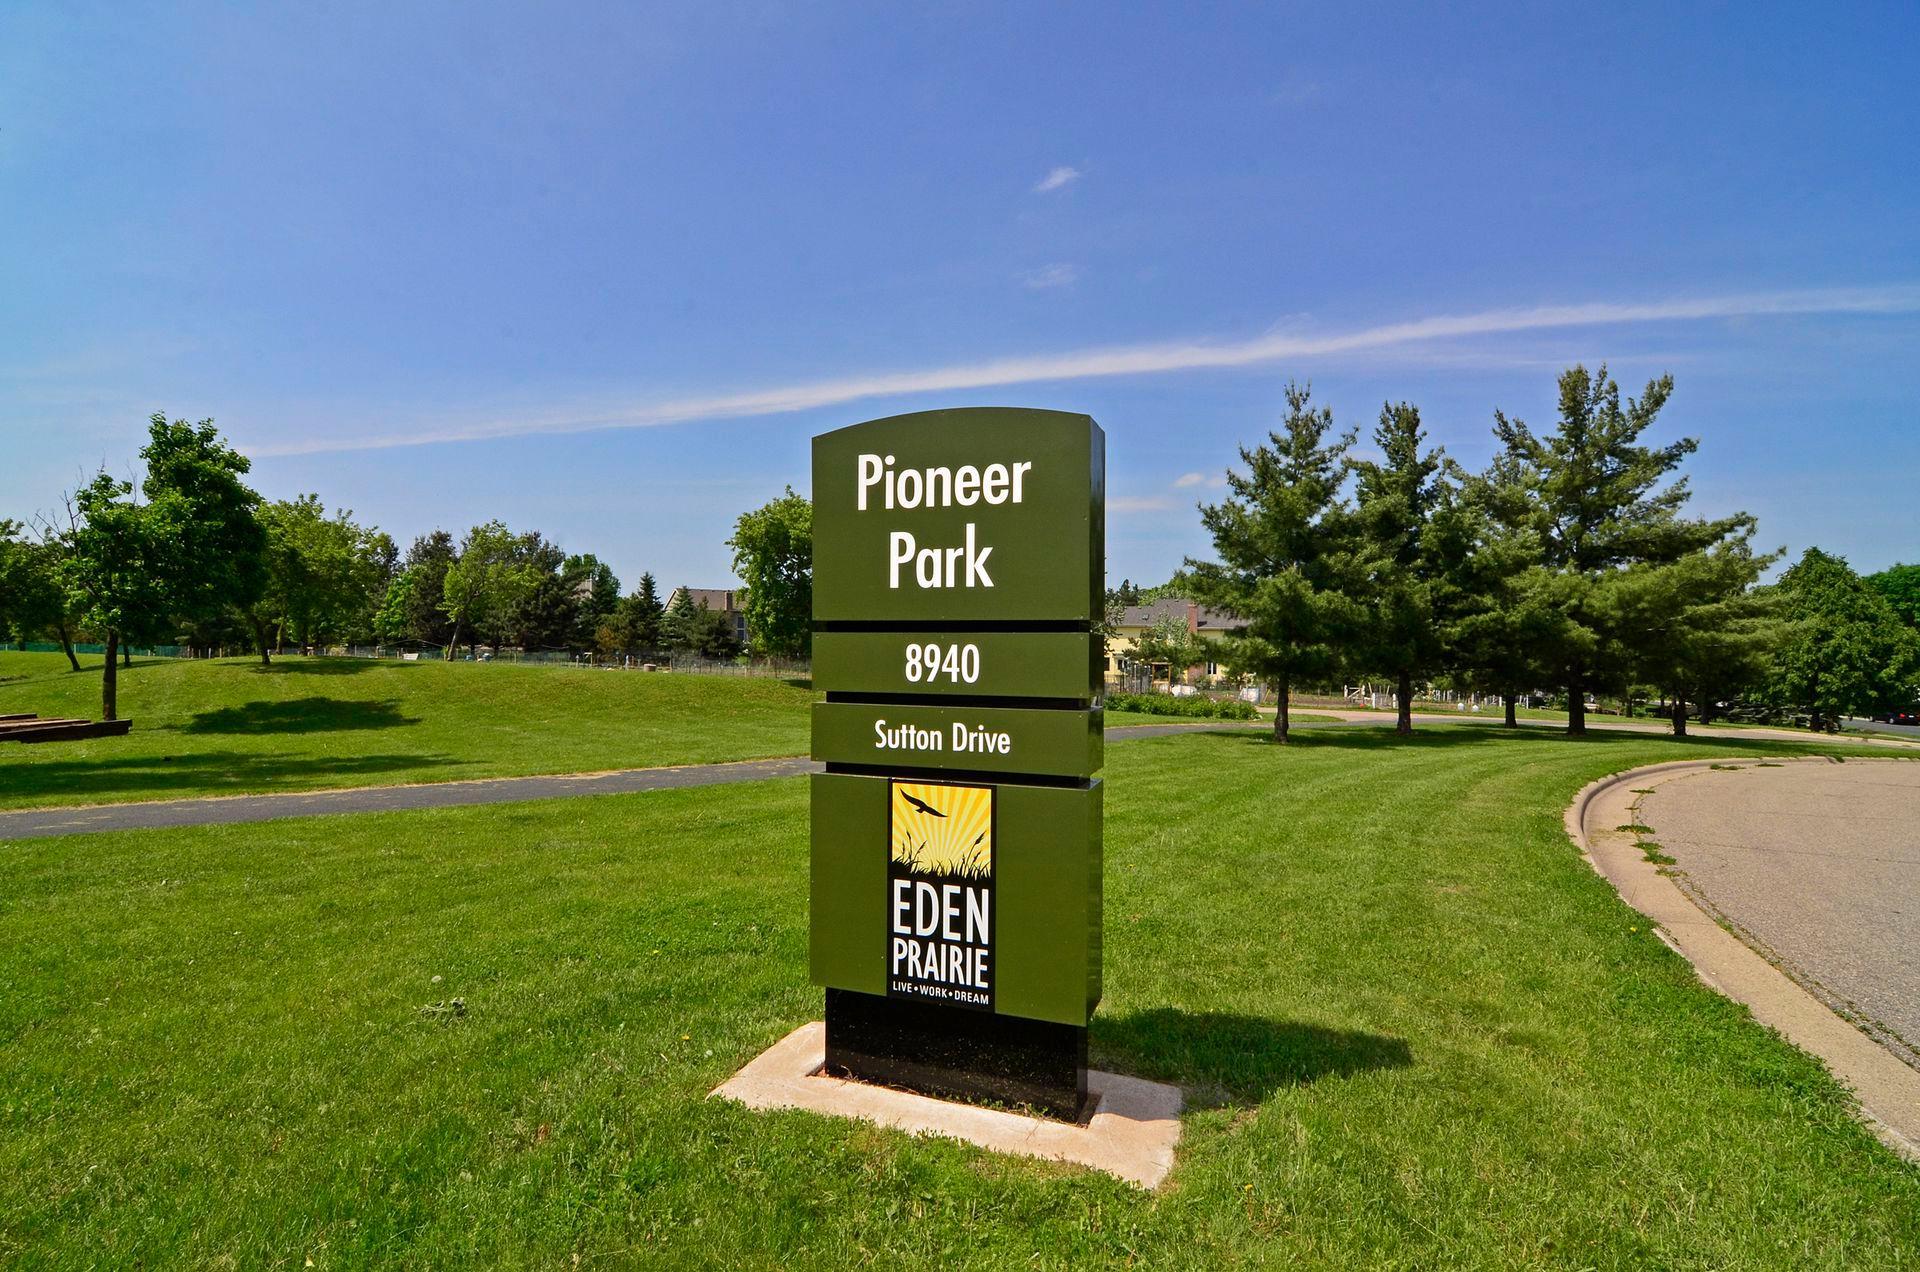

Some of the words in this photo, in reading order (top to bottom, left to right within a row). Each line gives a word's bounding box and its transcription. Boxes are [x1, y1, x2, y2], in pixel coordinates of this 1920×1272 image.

[857, 453, 1032, 511] Pioneer
[889, 522, 995, 589] Park
[905, 643, 980, 684] 8940
[874, 719, 943, 751] Sutton
[952, 722, 1011, 754] Drive
[893, 878, 989, 945] EDEN
[893, 937, 989, 989] PRAIRIE
